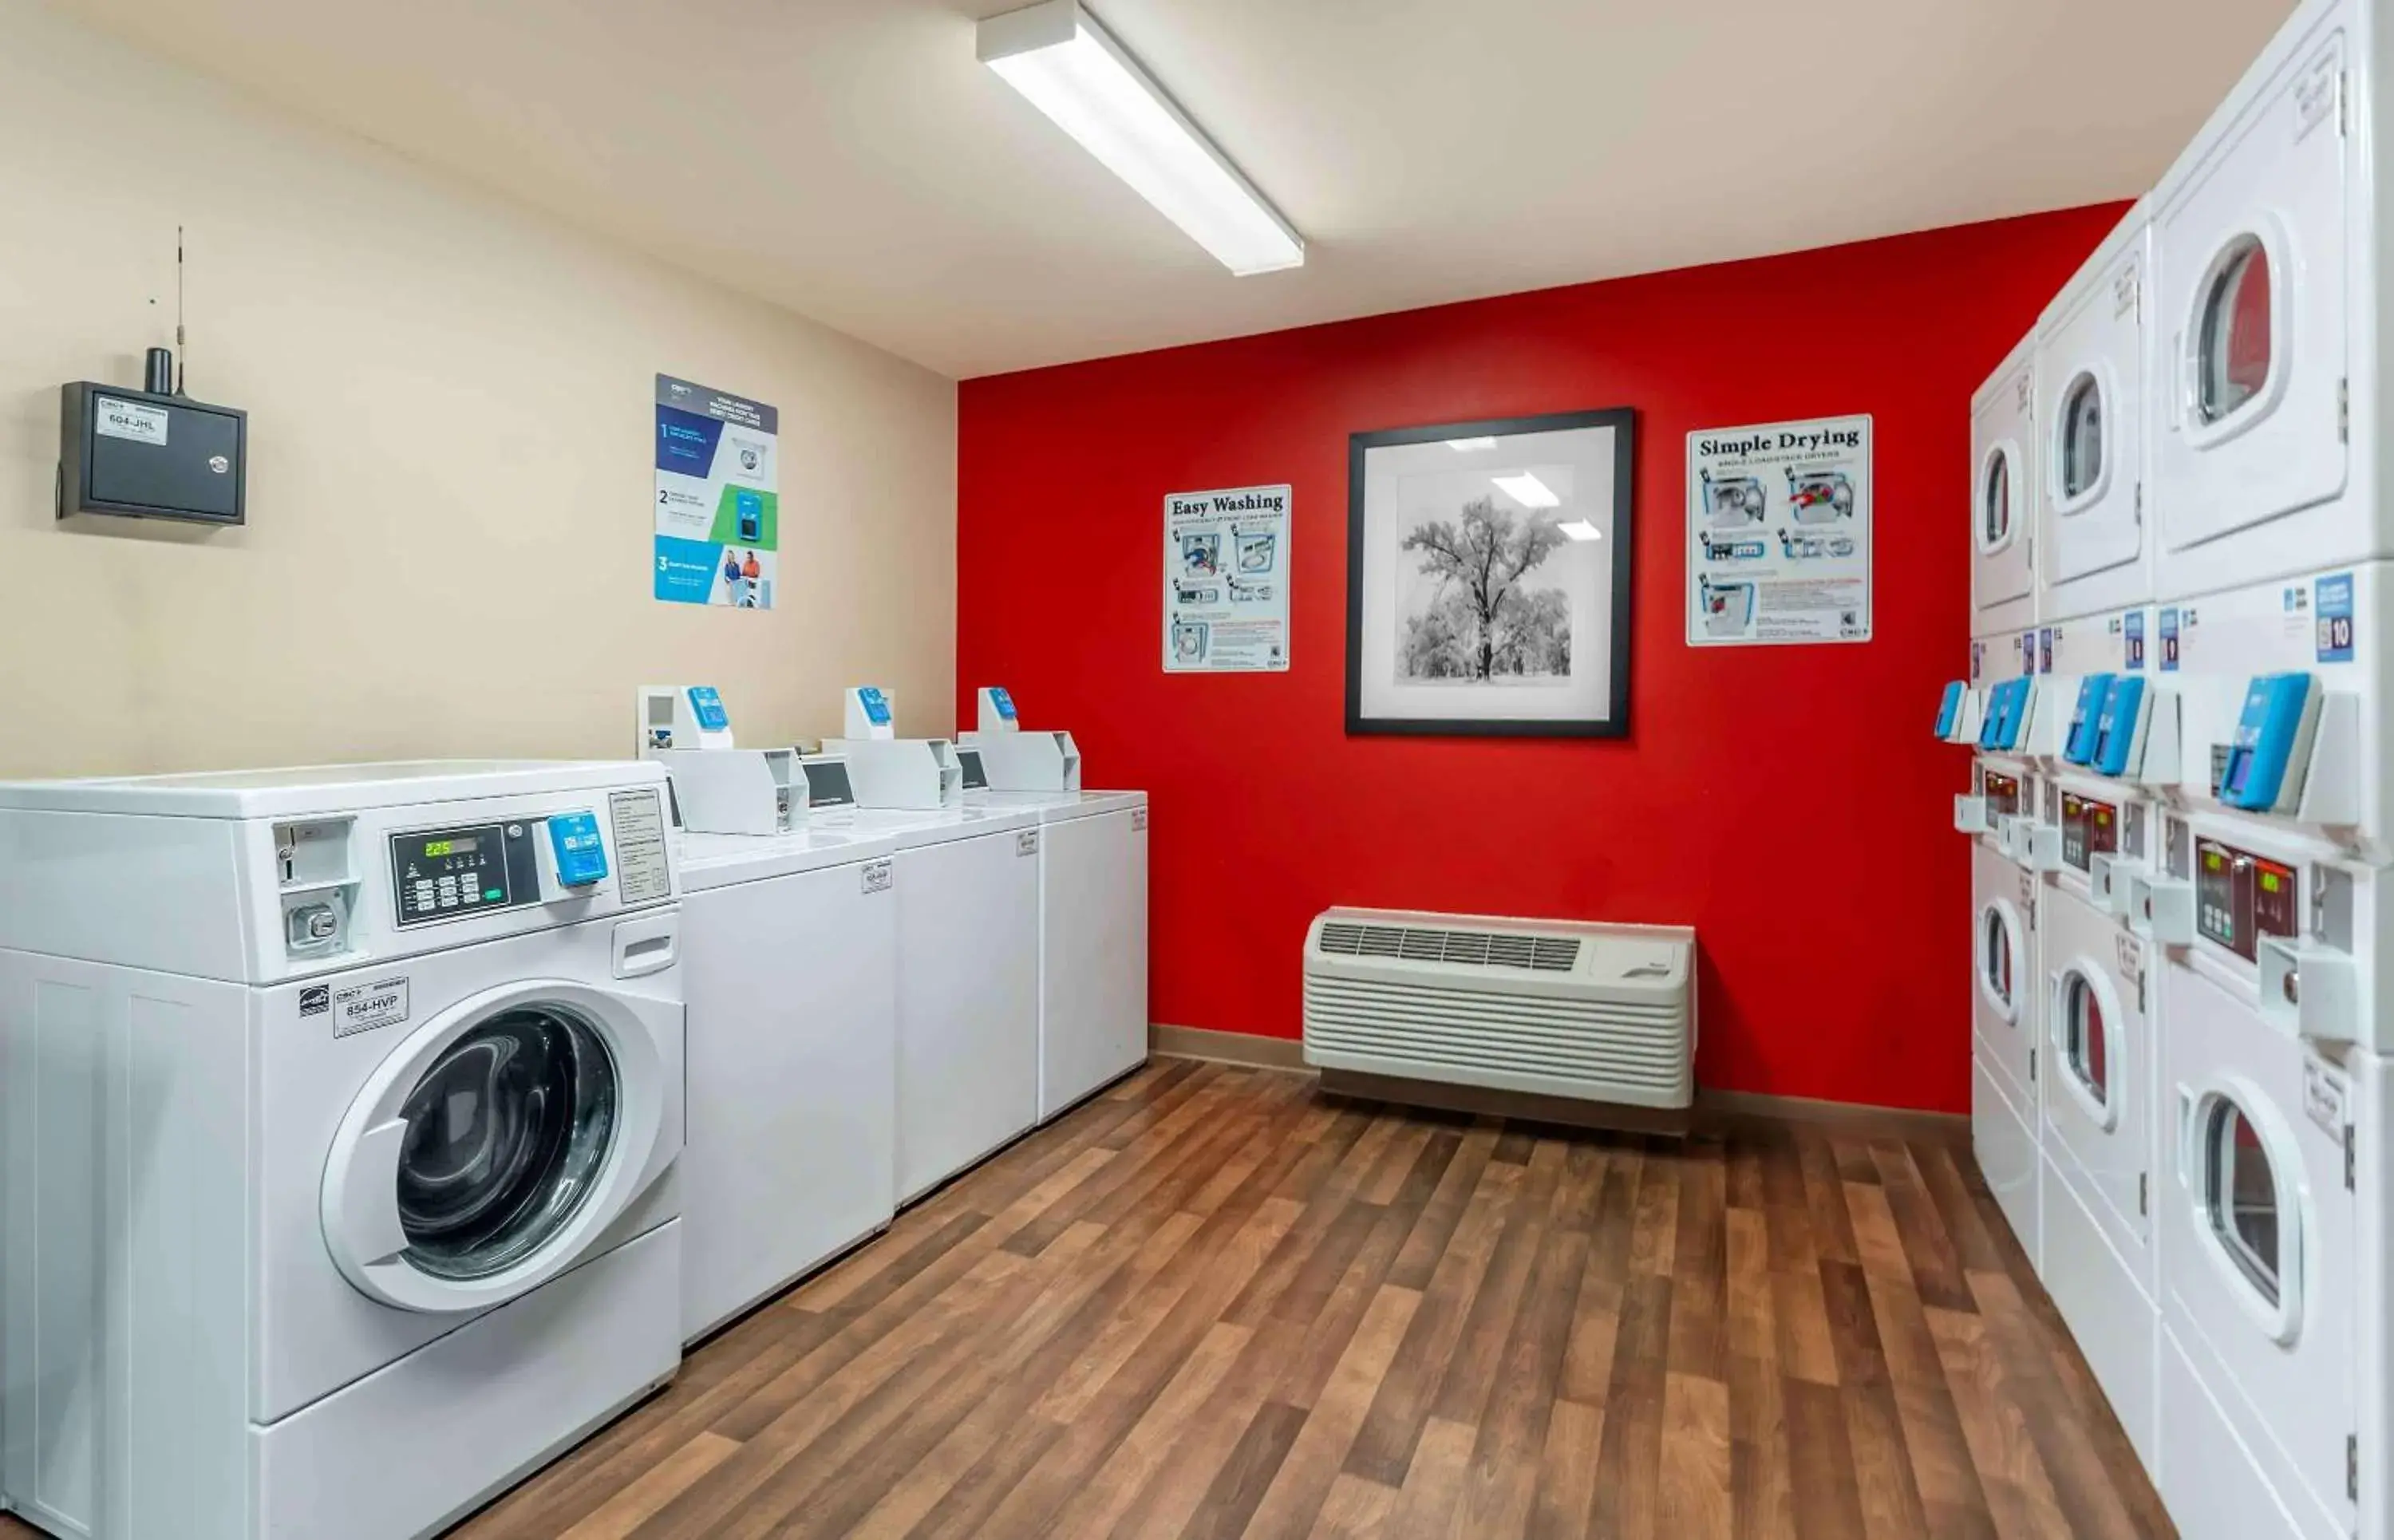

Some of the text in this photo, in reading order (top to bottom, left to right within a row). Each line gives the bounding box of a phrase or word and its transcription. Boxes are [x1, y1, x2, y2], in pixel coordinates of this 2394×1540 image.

[661, 424, 668, 438] 1
[1700, 428, 1859, 456] Simple Drying
[659, 490, 668, 503] 2
[1172, 494, 1283, 517] Easy Washing
[658, 556, 668, 571] 3
[2333, 619, 2349, 646] 10
[347, 995, 398, 1016] 854-HVP
